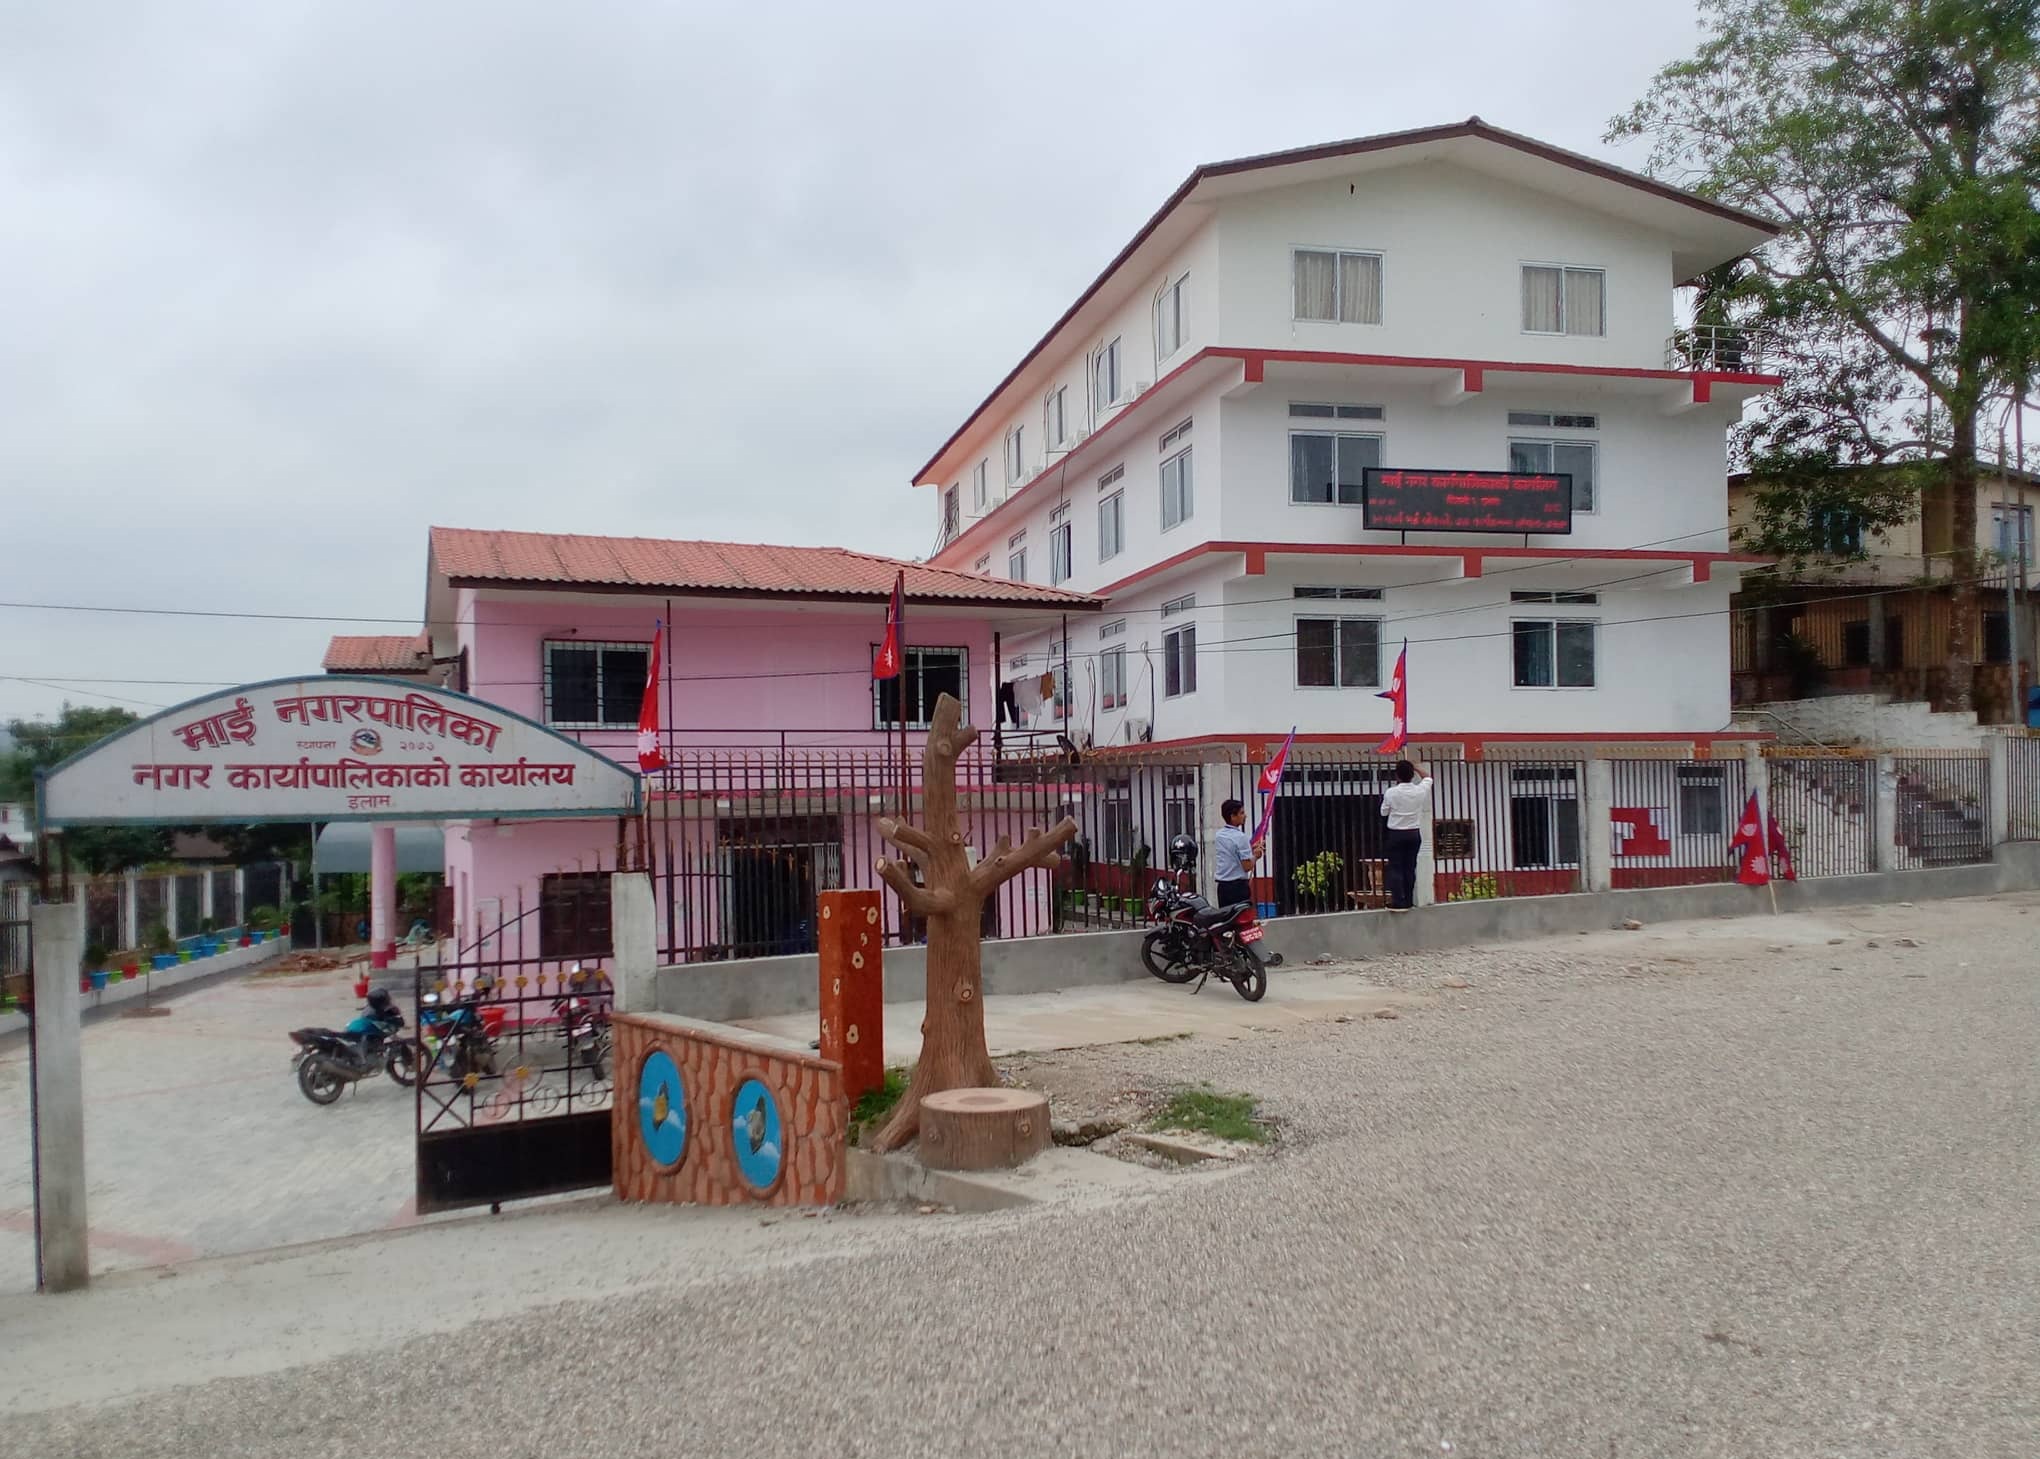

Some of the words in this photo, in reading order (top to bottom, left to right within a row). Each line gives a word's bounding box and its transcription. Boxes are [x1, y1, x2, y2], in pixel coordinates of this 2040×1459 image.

[172, 698, 256, 752] माई
[274, 693, 503, 753] नगरपालिका
[131, 763, 212, 790] नगर
[459, 756, 575, 787] कार्यालय
[346, 794, 391, 809] इलाम
